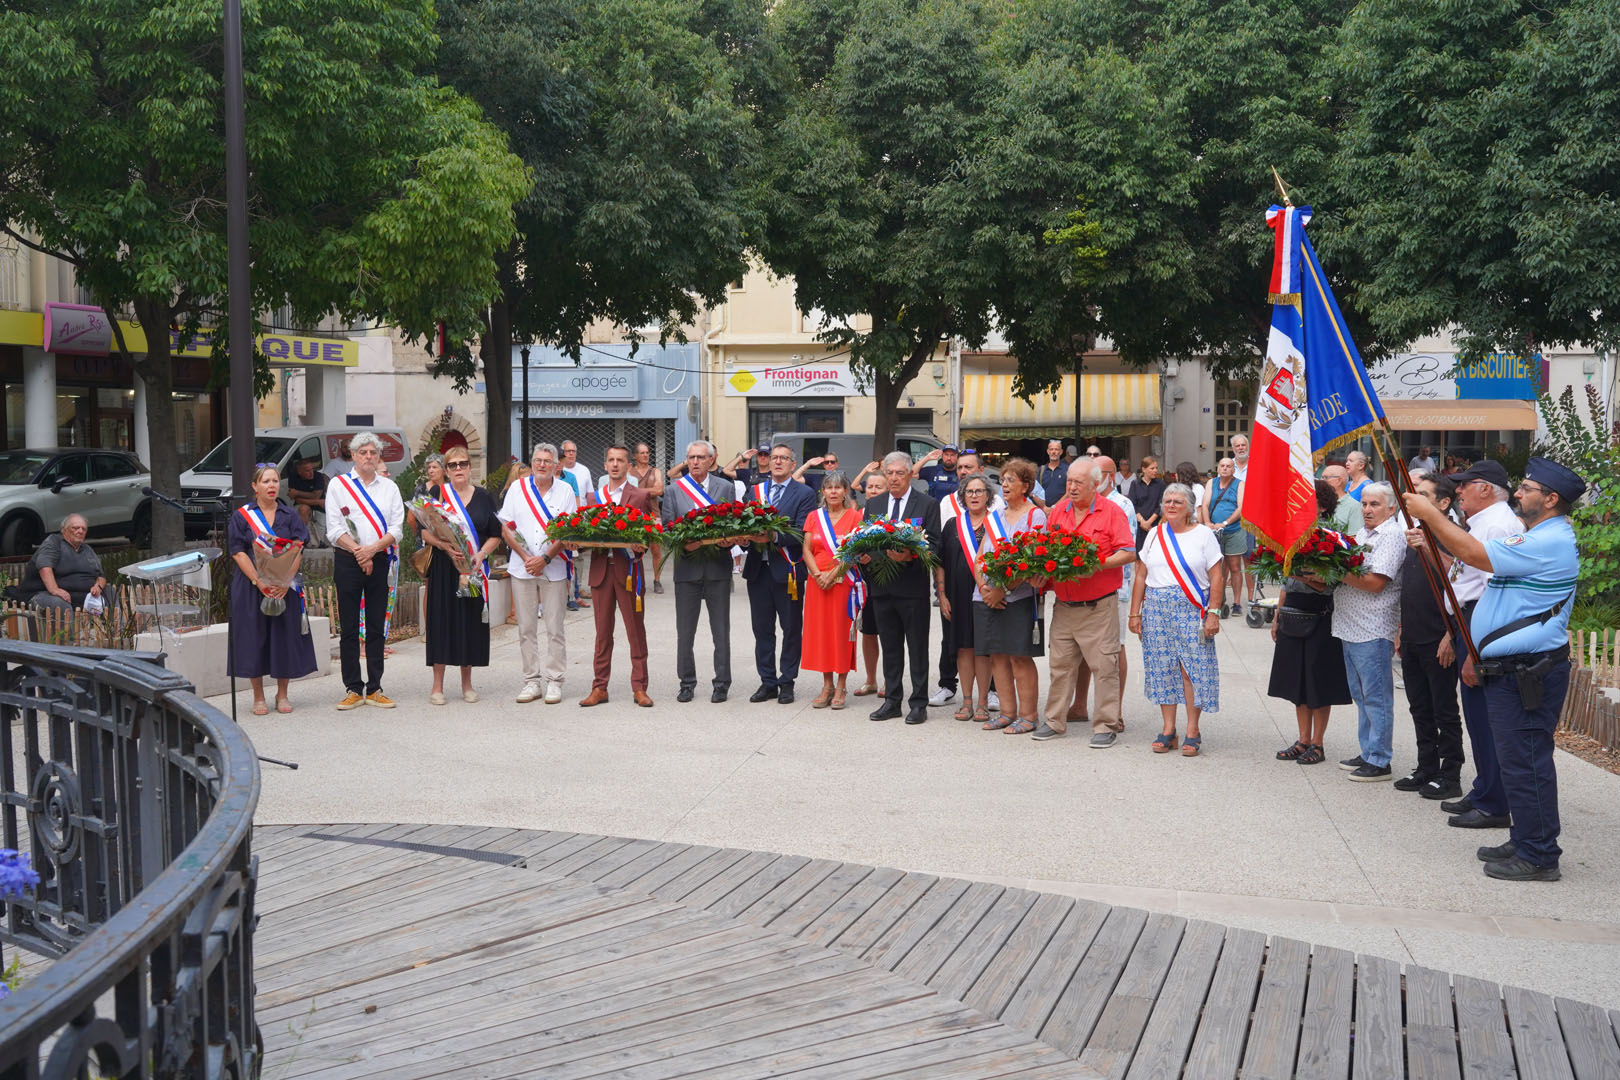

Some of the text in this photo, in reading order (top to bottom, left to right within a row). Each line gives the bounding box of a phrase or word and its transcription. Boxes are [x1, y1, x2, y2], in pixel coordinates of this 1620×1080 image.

[764, 367, 838, 383] Frontignan
[571, 374, 628, 391] apogée
[772, 379, 802, 388] immo
[527, 404, 543, 415] my
[545, 403, 574, 416] shop
[575, 404, 604, 417] yoga
[1414, 415, 1486, 426] GOURMANDE
[1000, 428, 1042, 438] FRUITS
